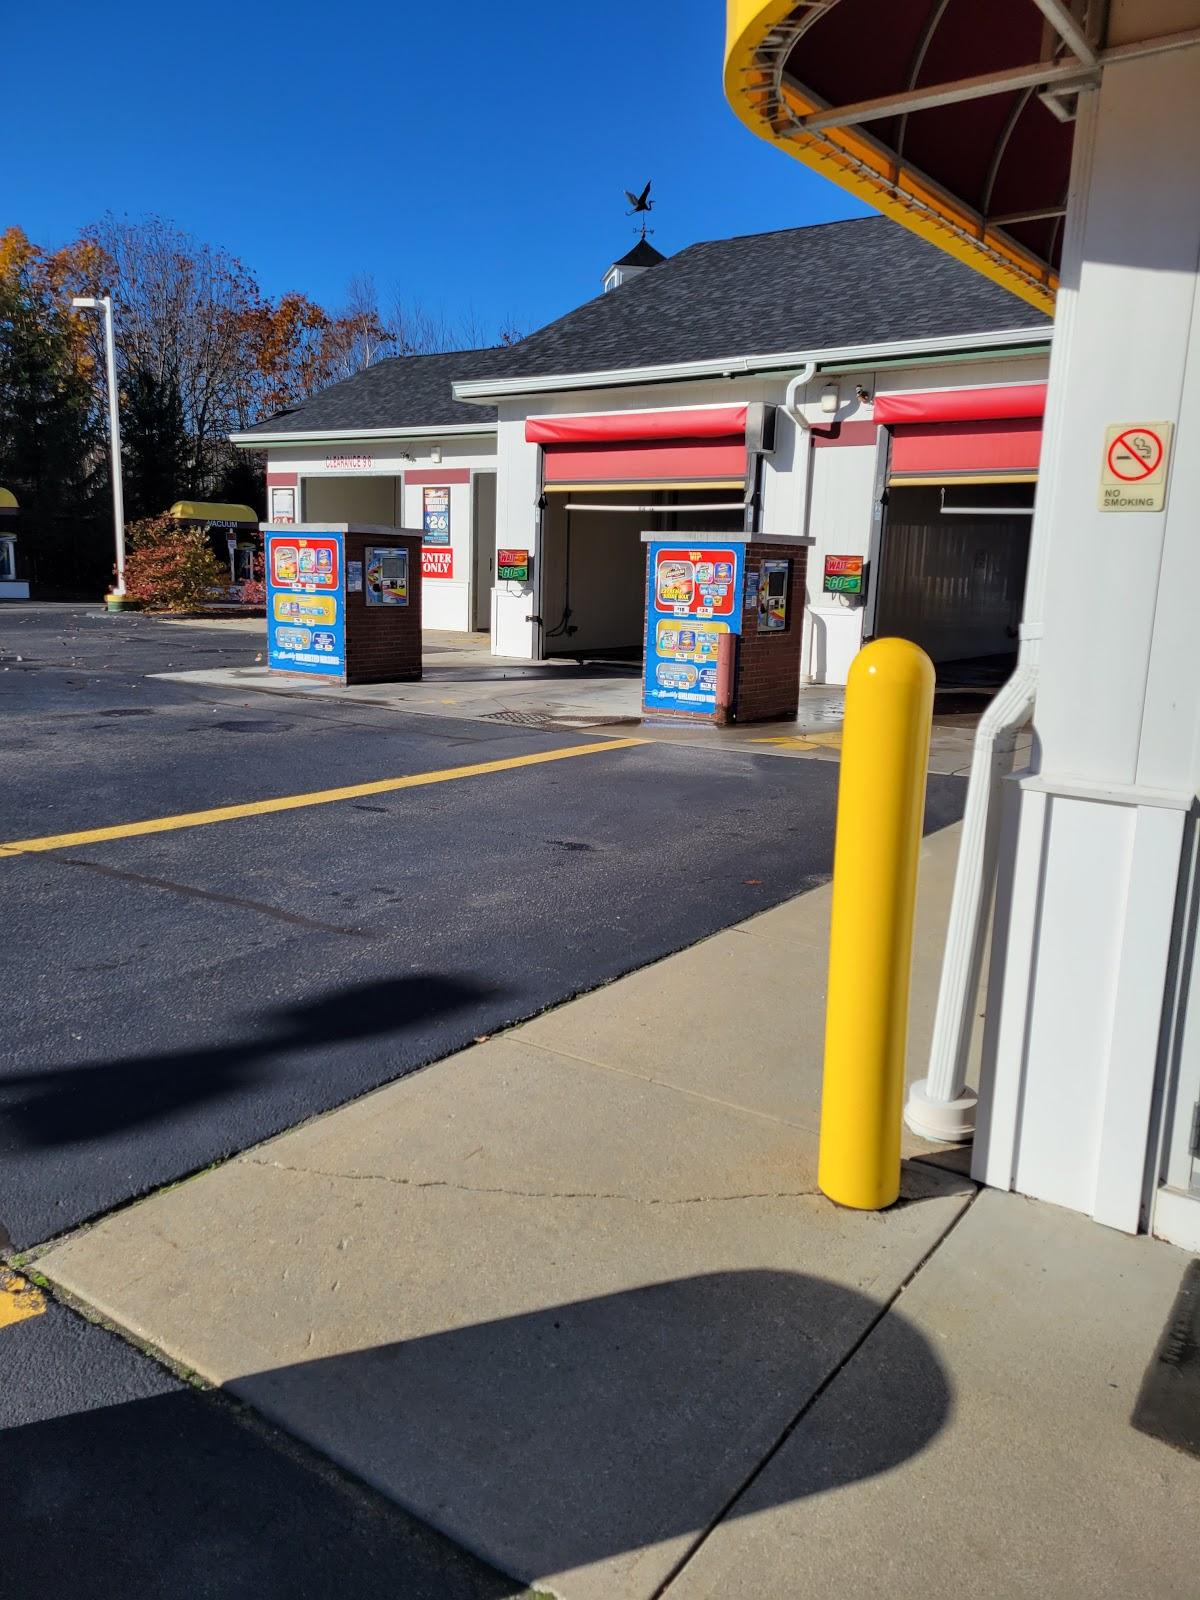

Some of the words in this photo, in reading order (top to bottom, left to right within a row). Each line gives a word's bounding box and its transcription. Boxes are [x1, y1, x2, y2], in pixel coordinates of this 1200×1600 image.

[326, 455, 361, 468] CLEARANCE
[1104, 489, 1121, 497] NO
[1103, 498, 1154, 507] SMOKING
[207, 520, 238, 528] VACUUM
[422, 553, 452, 564] ENTER
[498, 553, 515, 563] WAIT
[422, 562, 450, 573] ONLY
[827, 559, 848, 570] WAIT
[501, 566, 515, 578] GO
[828, 575, 846, 590] GO
